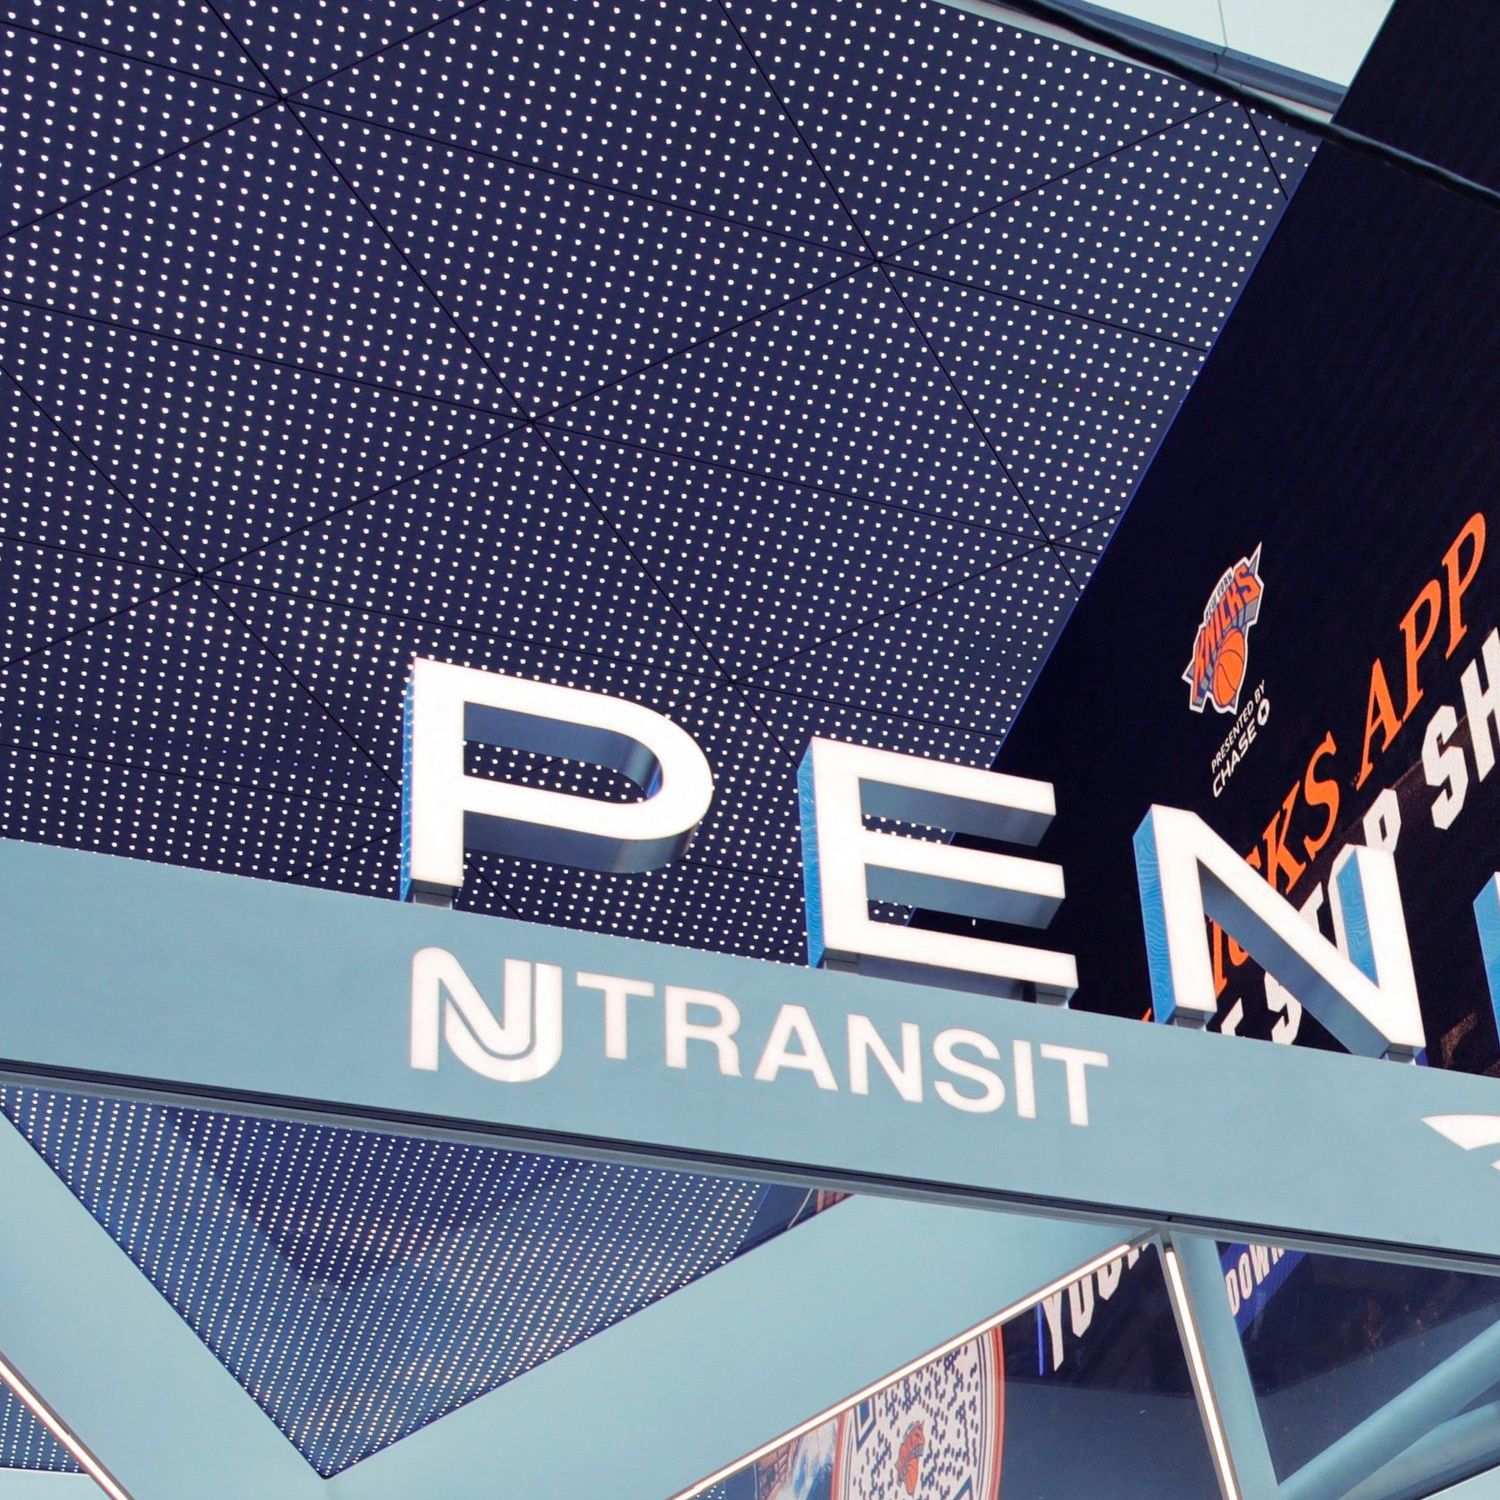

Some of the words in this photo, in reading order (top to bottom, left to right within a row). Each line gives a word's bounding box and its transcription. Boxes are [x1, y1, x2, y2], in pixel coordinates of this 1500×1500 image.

[1191, 563, 1262, 705] KNICKS
[1216, 571, 1235, 598] YORK
[1356, 511, 1488, 791] APP
[1210, 698, 1254, 775] PRESENTED
[1253, 679, 1267, 706] BY
[1212, 718, 1259, 799] CHASE
[410, 946, 563, 1083] NJ
[575, 971, 1110, 1127] TRANSIT
